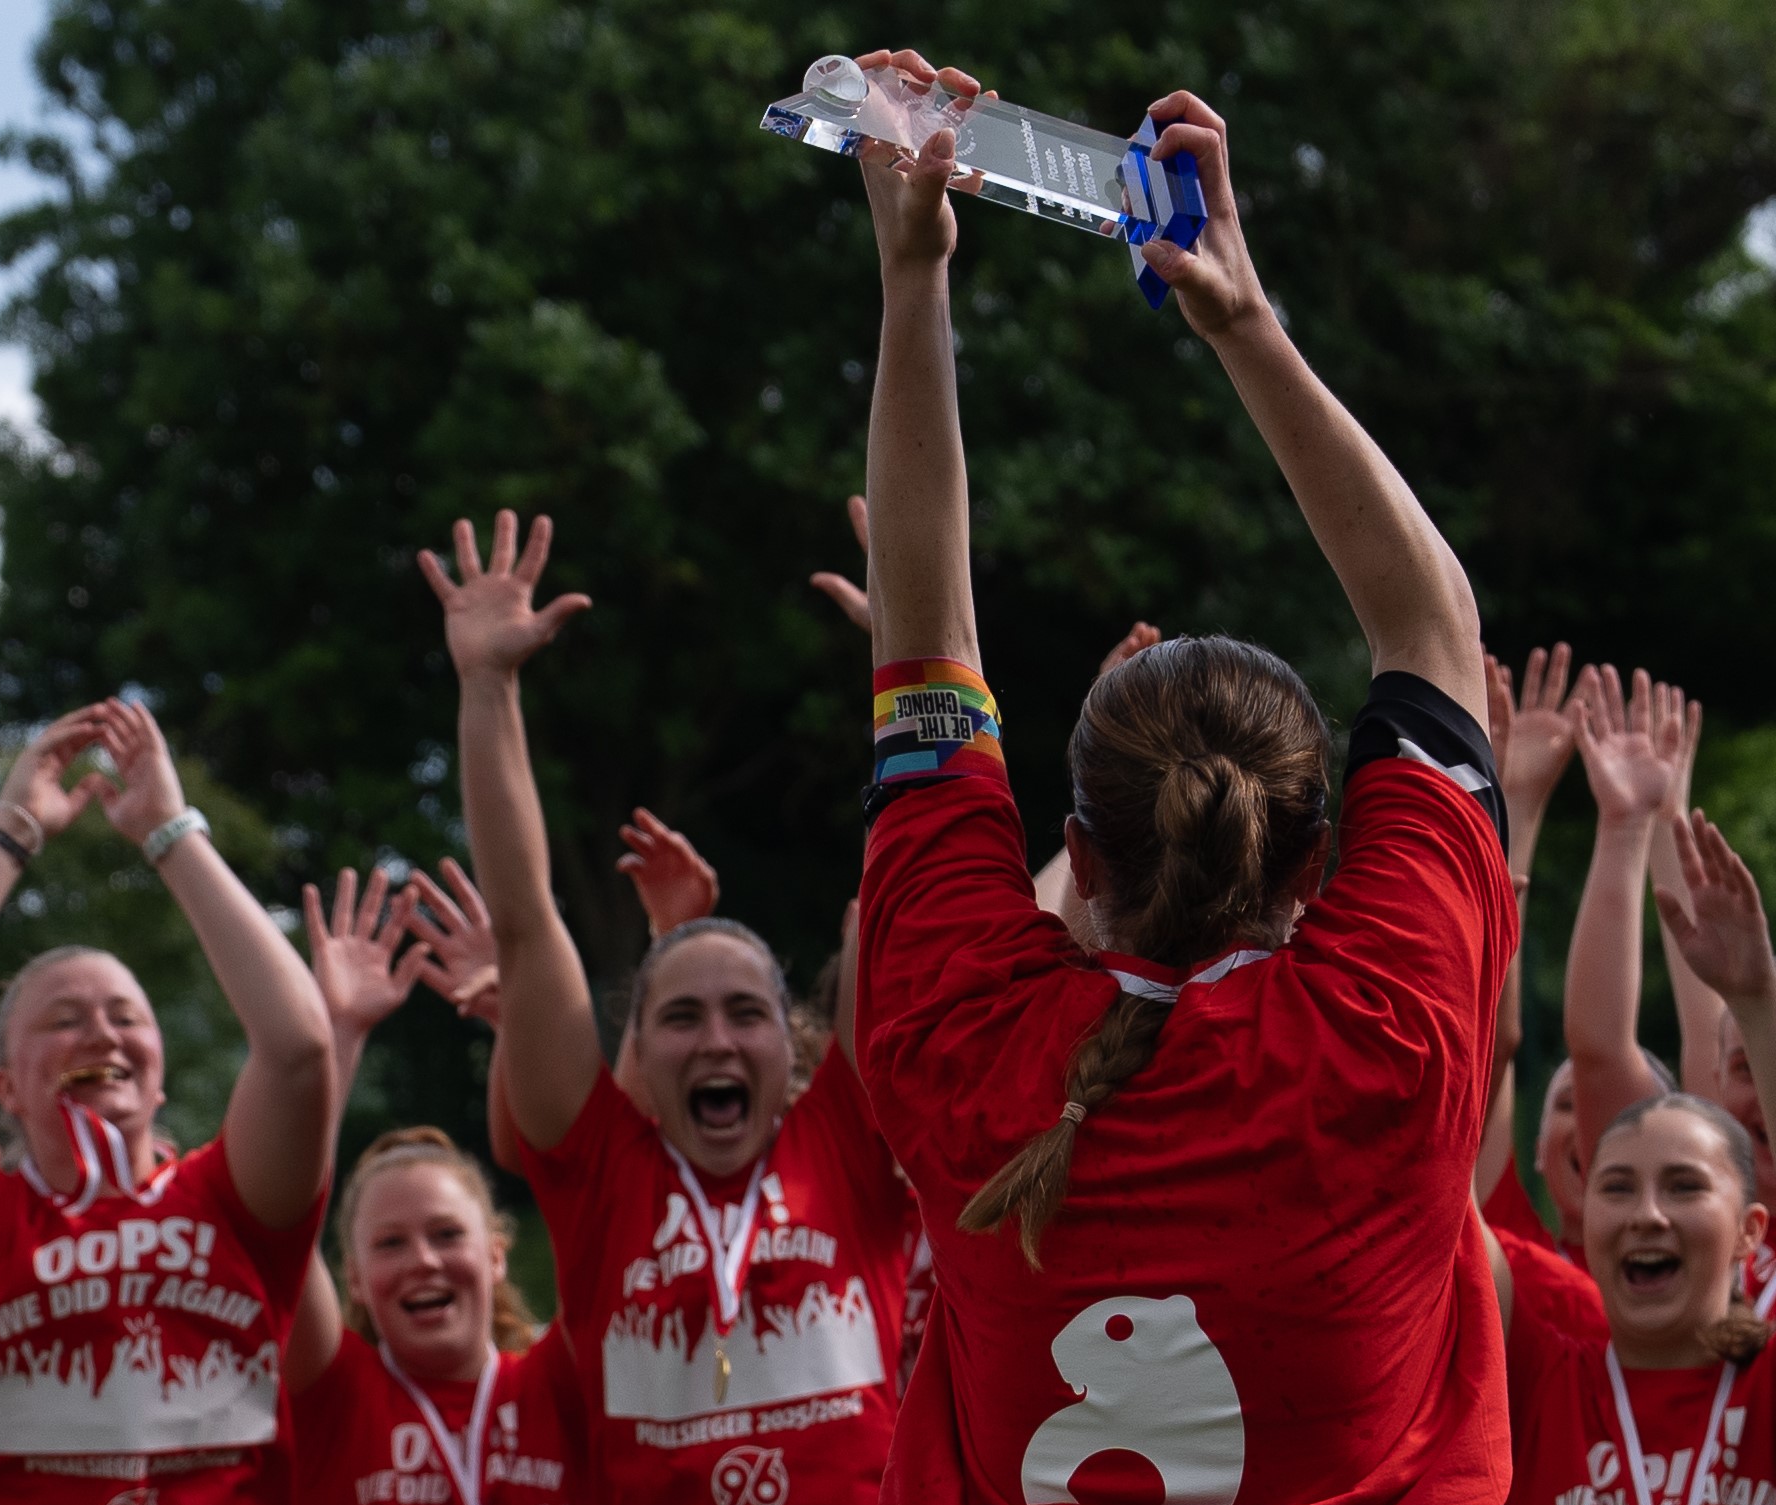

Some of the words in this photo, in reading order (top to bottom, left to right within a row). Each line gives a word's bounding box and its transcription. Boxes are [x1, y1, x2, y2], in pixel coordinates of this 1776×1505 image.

[1061, 144, 1081, 196] Pokalsieger
[895, 691, 960, 719] CHANGE
[918, 716, 951, 741] THE
[951, 716, 972, 740] BE
[32, 1215, 216, 1285] OOPS!
[749, 1226, 838, 1269] AGAIN
[47, 1275, 111, 1320] DID
[116, 1272, 155, 1306] IT
[153, 1275, 263, 1330] AGAIN
